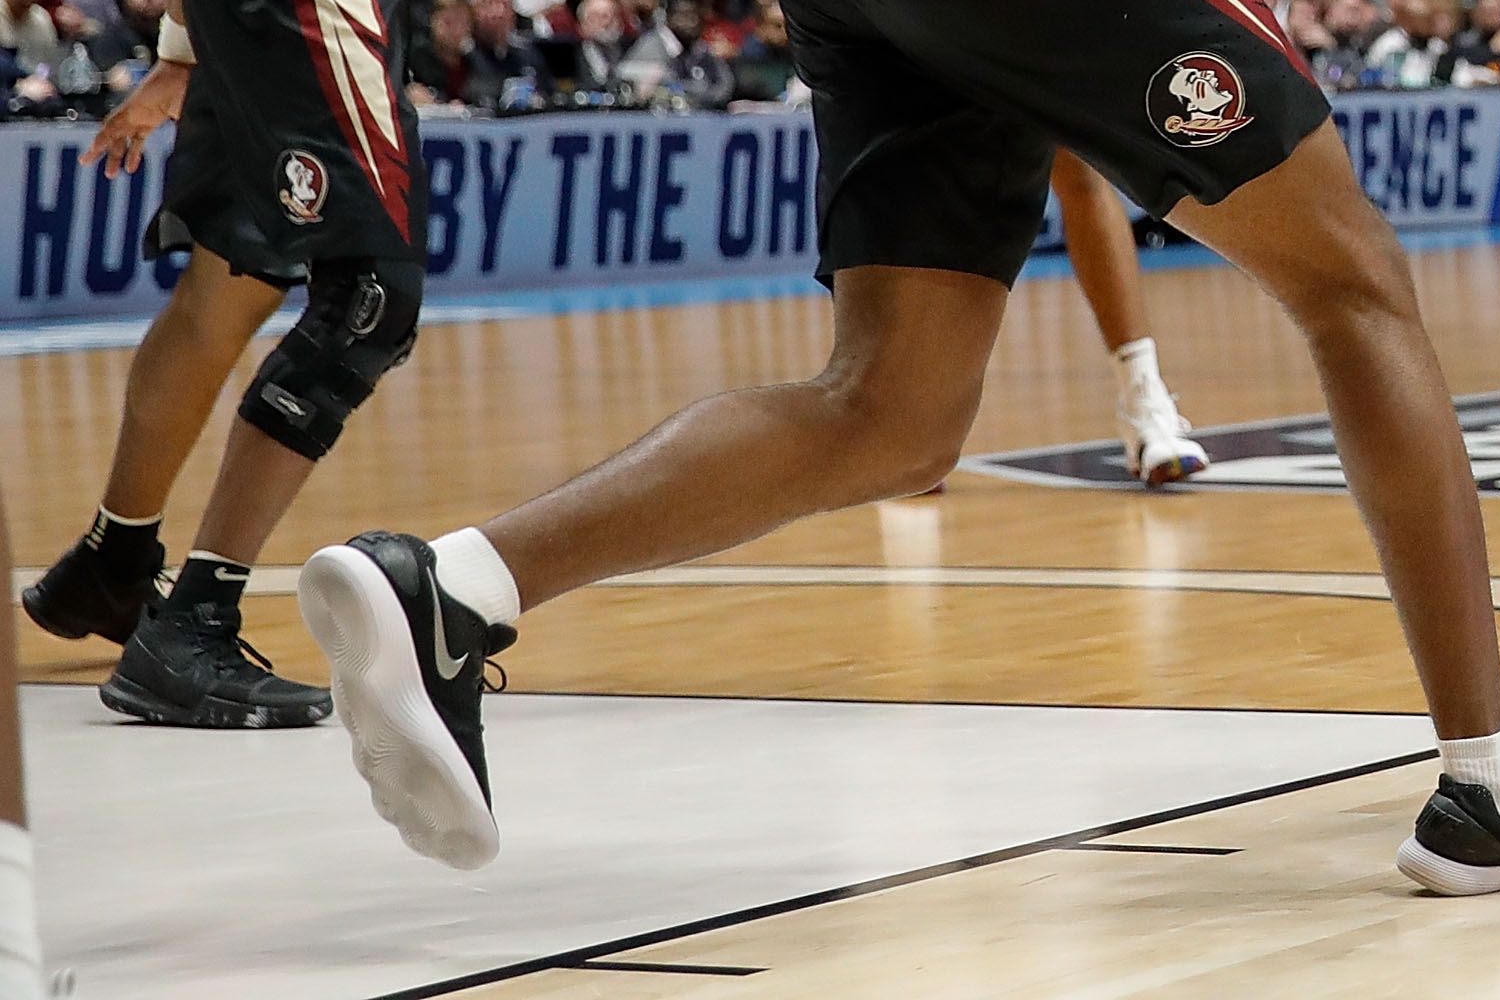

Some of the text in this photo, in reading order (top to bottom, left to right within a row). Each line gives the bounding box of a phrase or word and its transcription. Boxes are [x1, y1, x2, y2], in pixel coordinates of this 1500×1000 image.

[19, 143, 188, 300] HO
[425, 136, 526, 276] BY
[550, 132, 690, 269] THE
[1335, 106, 1478, 209] ENCE
